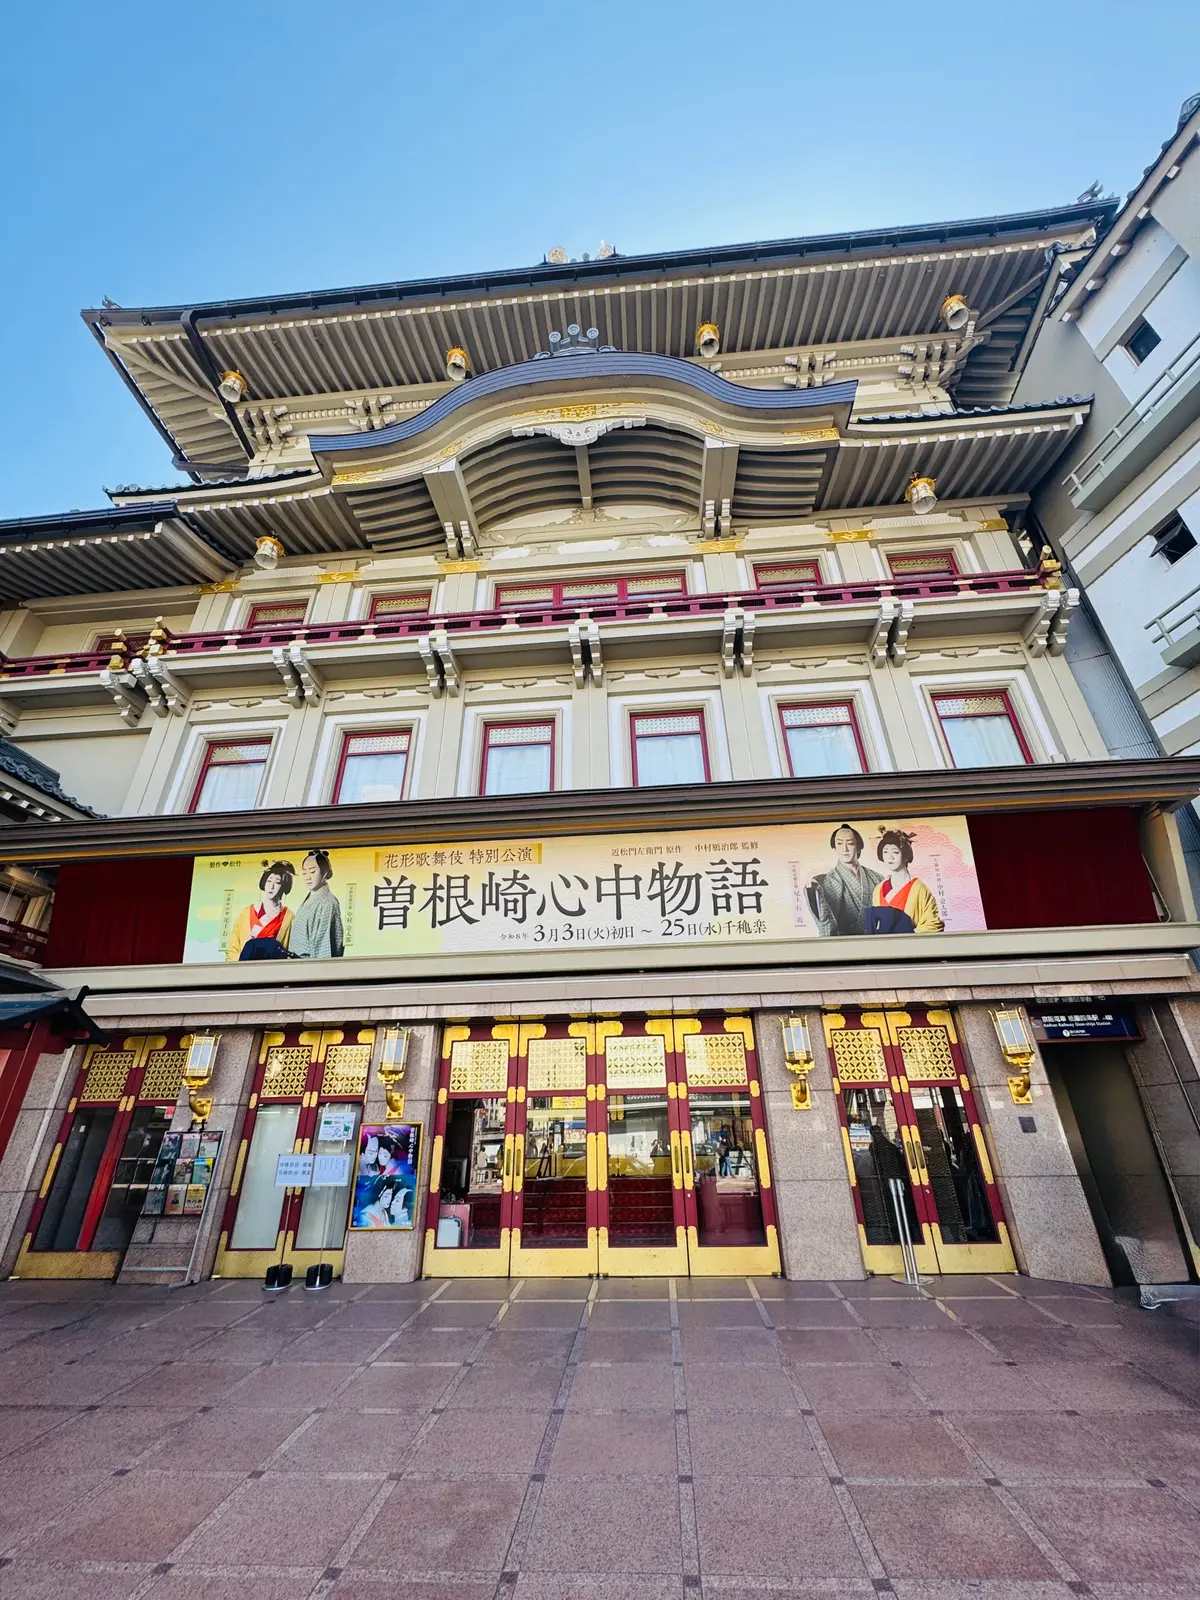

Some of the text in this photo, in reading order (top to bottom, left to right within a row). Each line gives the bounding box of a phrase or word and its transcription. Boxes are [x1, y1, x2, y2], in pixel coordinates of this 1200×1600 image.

[384, 847, 533, 869] 花形歌舞伎 特別公演
[611, 846, 663, 857] 近松門左衛門
[666, 845, 683, 854] 原作
[741, 841, 759, 850] 監修
[373, 857, 769, 931] 曽根崎心中物語
[499, 932, 530, 941] 令和8年
